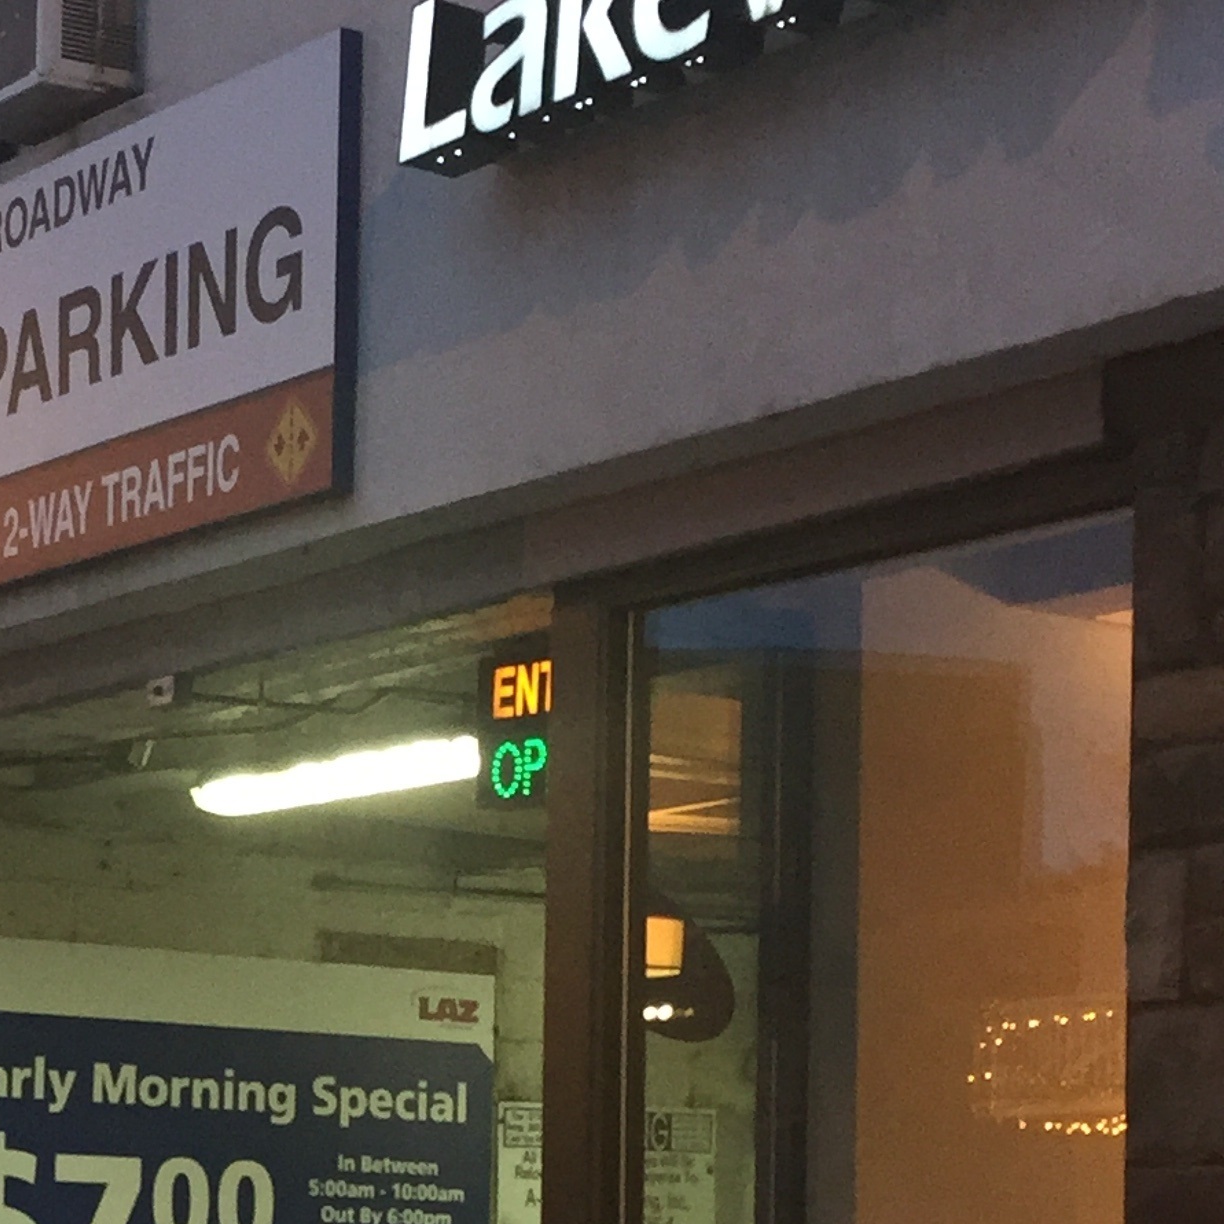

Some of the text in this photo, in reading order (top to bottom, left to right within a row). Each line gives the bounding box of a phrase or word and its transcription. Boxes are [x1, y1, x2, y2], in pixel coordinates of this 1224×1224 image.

[3, 480, 92, 558] 2-WAY
[101, 434, 240, 526] TRAFFIC
[418, 997, 479, 1023] LAZ
[92, 1062, 297, 1125] Morning
[312, 1076, 468, 1127] Special
[338, 1154, 439, 1176] In Between
[308, 1179, 375, 1198] 5:00am
[391, 1183, 465, 1203] 10:00am
[321, 1206, 355, 1224] Out
